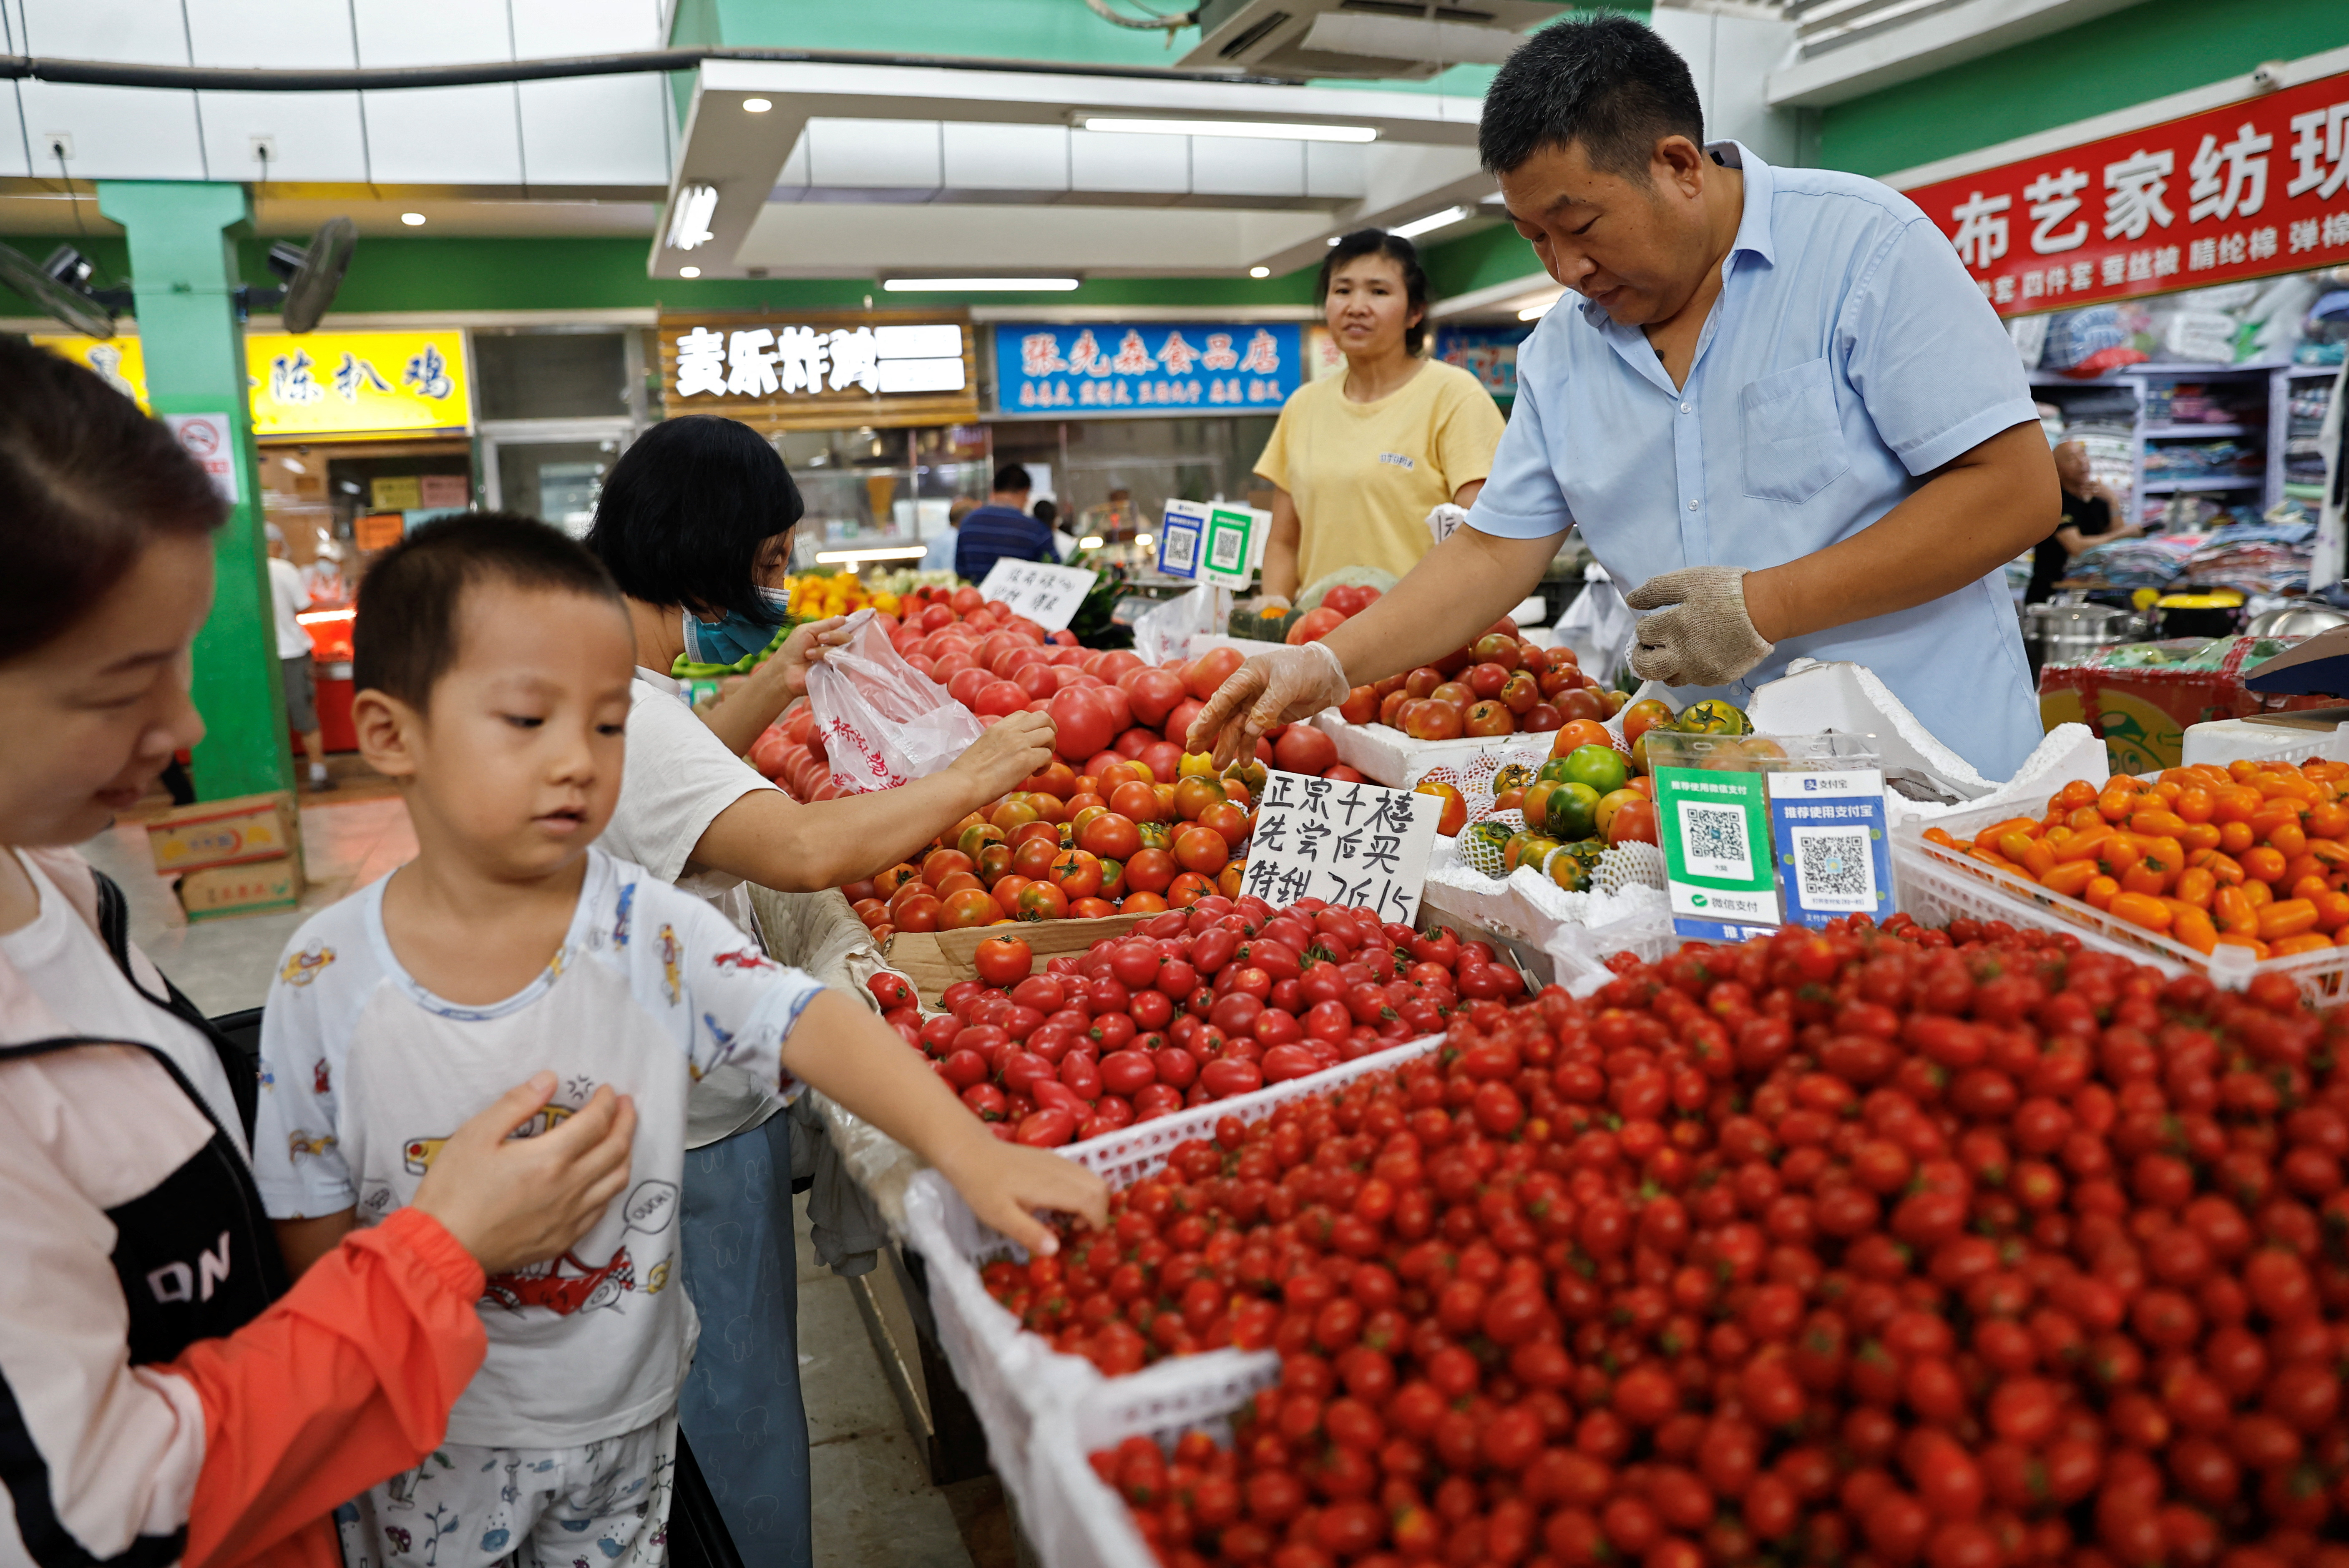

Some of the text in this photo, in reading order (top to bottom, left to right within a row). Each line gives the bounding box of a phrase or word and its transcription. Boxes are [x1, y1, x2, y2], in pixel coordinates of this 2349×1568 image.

[2022, 260, 2094, 299] 四件套
[2102, 245, 2180, 287] 蚕丝被
[1021, 329, 1280, 377] 张先森食品店
[1671, 780, 1747, 795] 推荐使用微信支付
[1819, 779, 1848, 790] 支付宝
[1264, 776, 1414, 833] 正宗千禧
[1784, 805, 1874, 819] 推荐使用支付宝
[1252, 814, 1401, 874] 先尝后买
[1712, 897, 1758, 912] 微信支付
